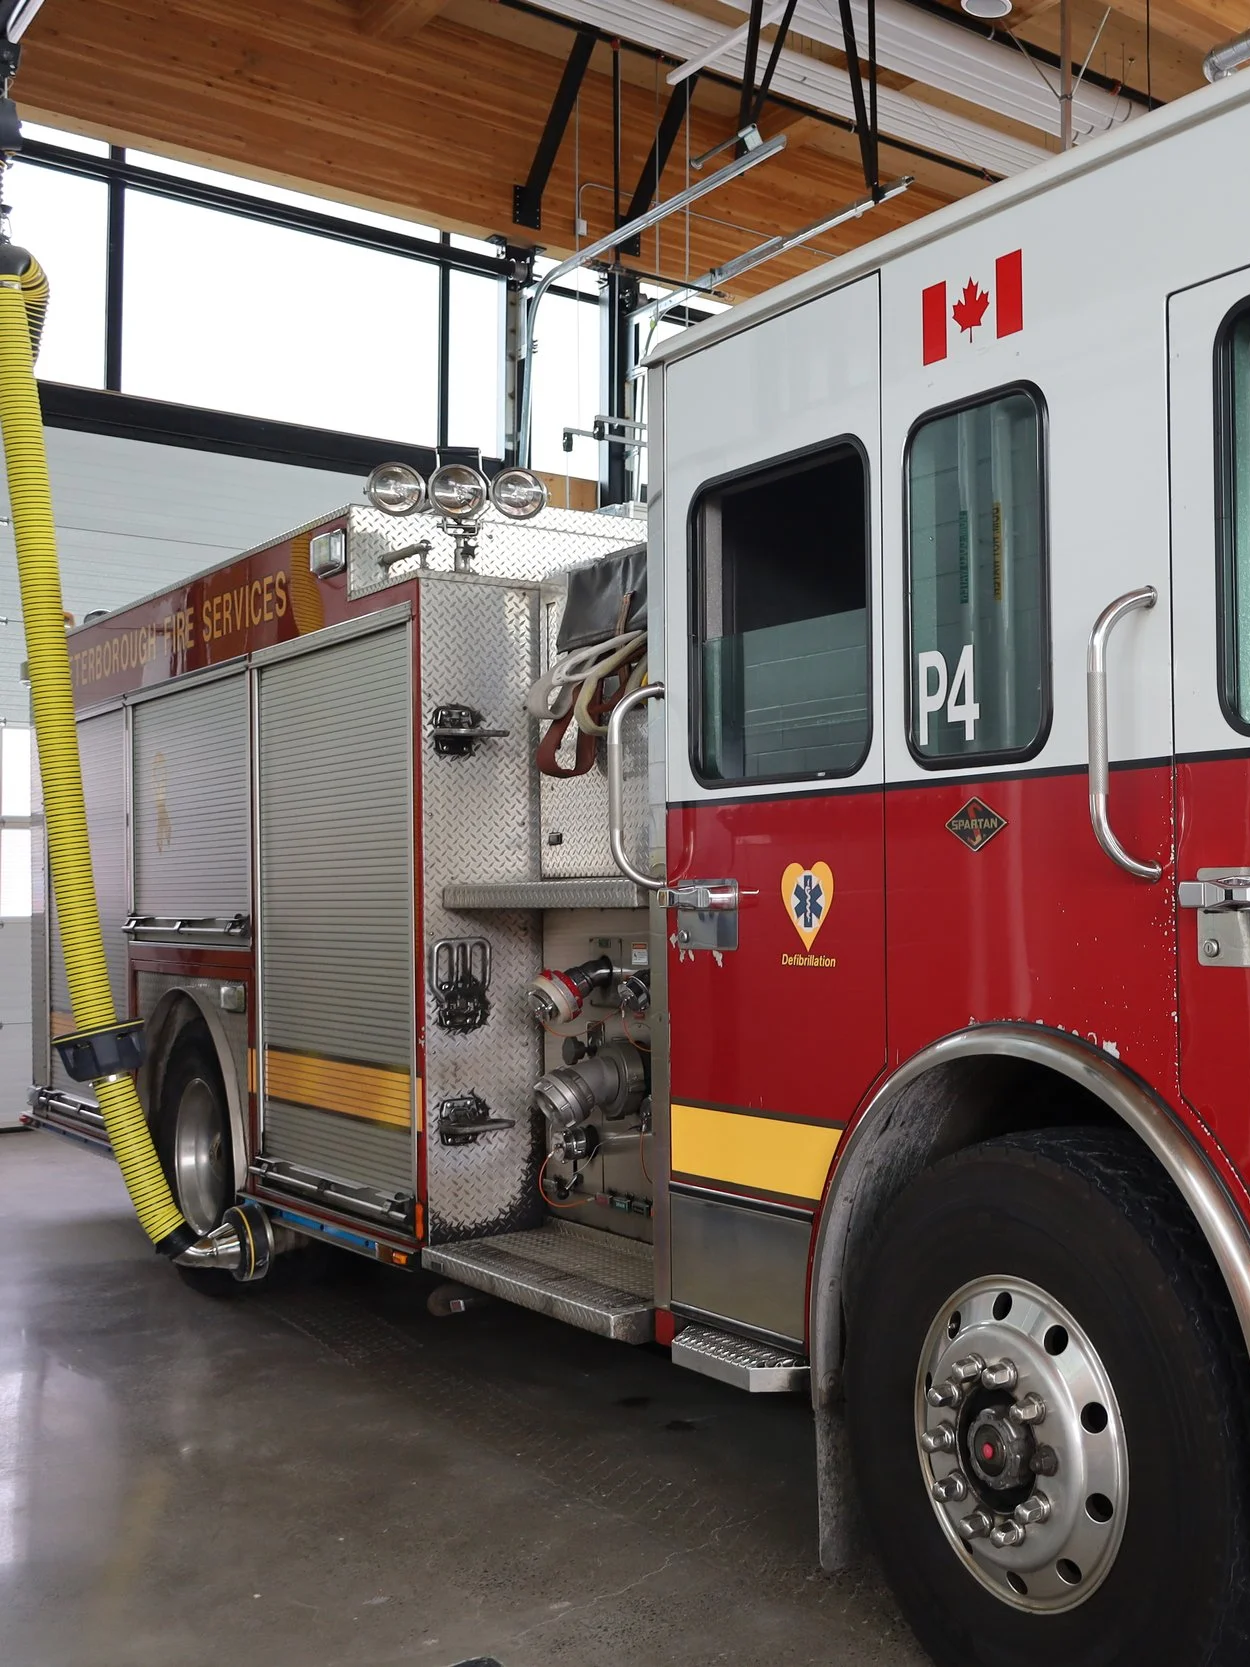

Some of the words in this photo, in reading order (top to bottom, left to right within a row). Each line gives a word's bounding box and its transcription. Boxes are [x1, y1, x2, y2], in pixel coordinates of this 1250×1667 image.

[70, 622, 156, 687] TERBOROUGH
[164, 607, 195, 656] FIRE
[202, 571, 287, 642] SERVICES
[918, 644, 980, 746] P4
[951, 818, 998, 830] SPARTAN
[781, 953, 836, 968] Defibrillation
